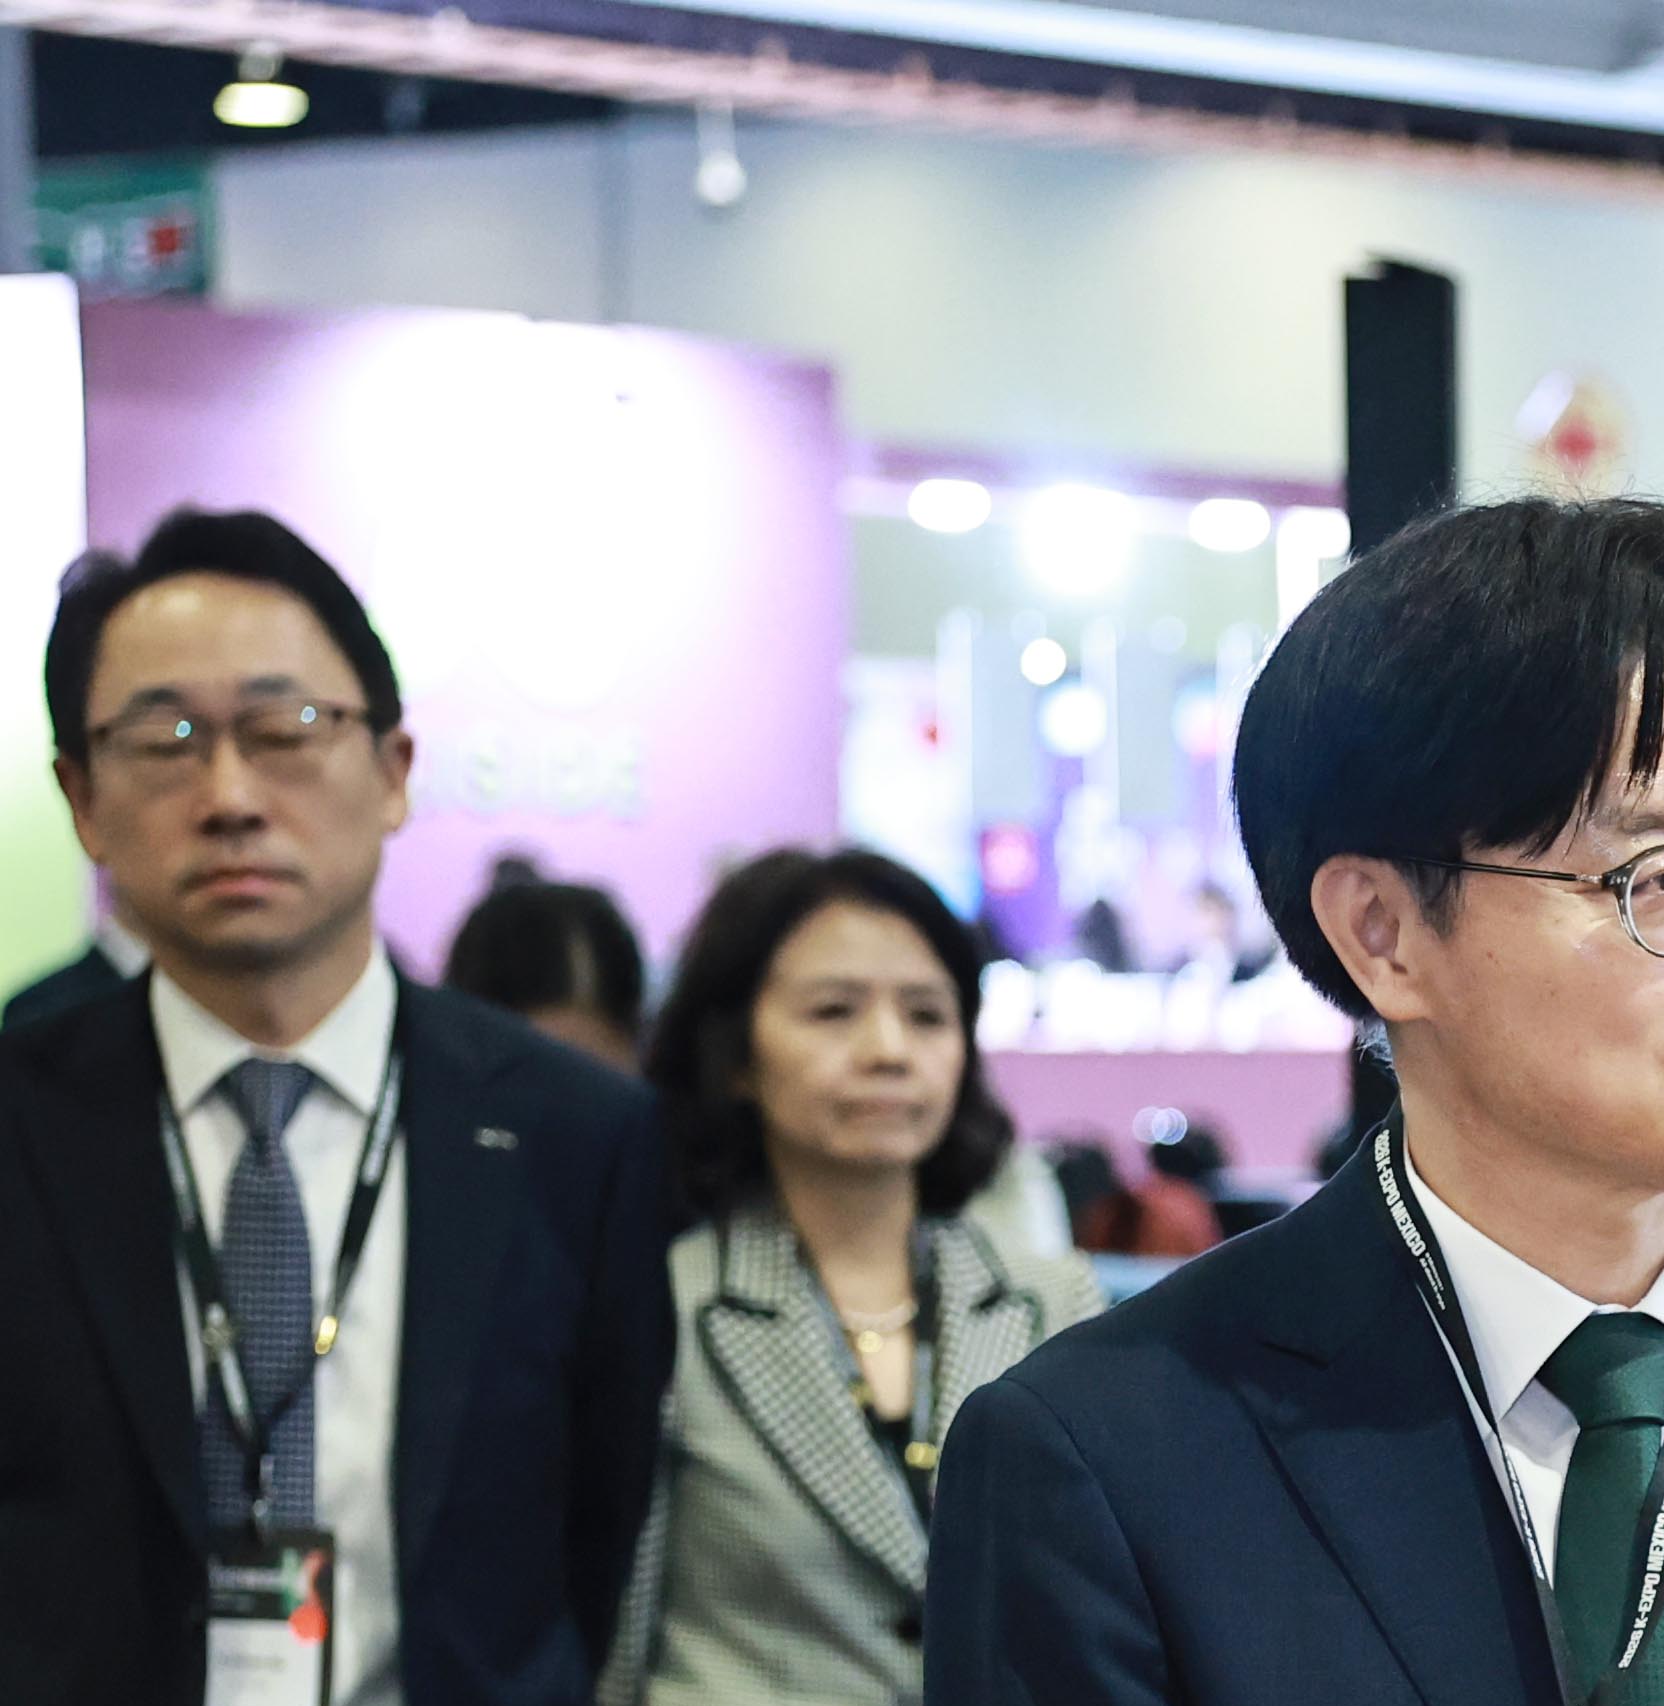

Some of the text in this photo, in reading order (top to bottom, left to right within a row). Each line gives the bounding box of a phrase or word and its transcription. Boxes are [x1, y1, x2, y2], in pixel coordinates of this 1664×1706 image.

[1377, 1158, 1401, 1206] K-EXPO
[1390, 1200, 1427, 1257] MEXICO
[1618, 1630, 1644, 1669] 2026
[1634, 1572, 1660, 1630] K-EXPO
